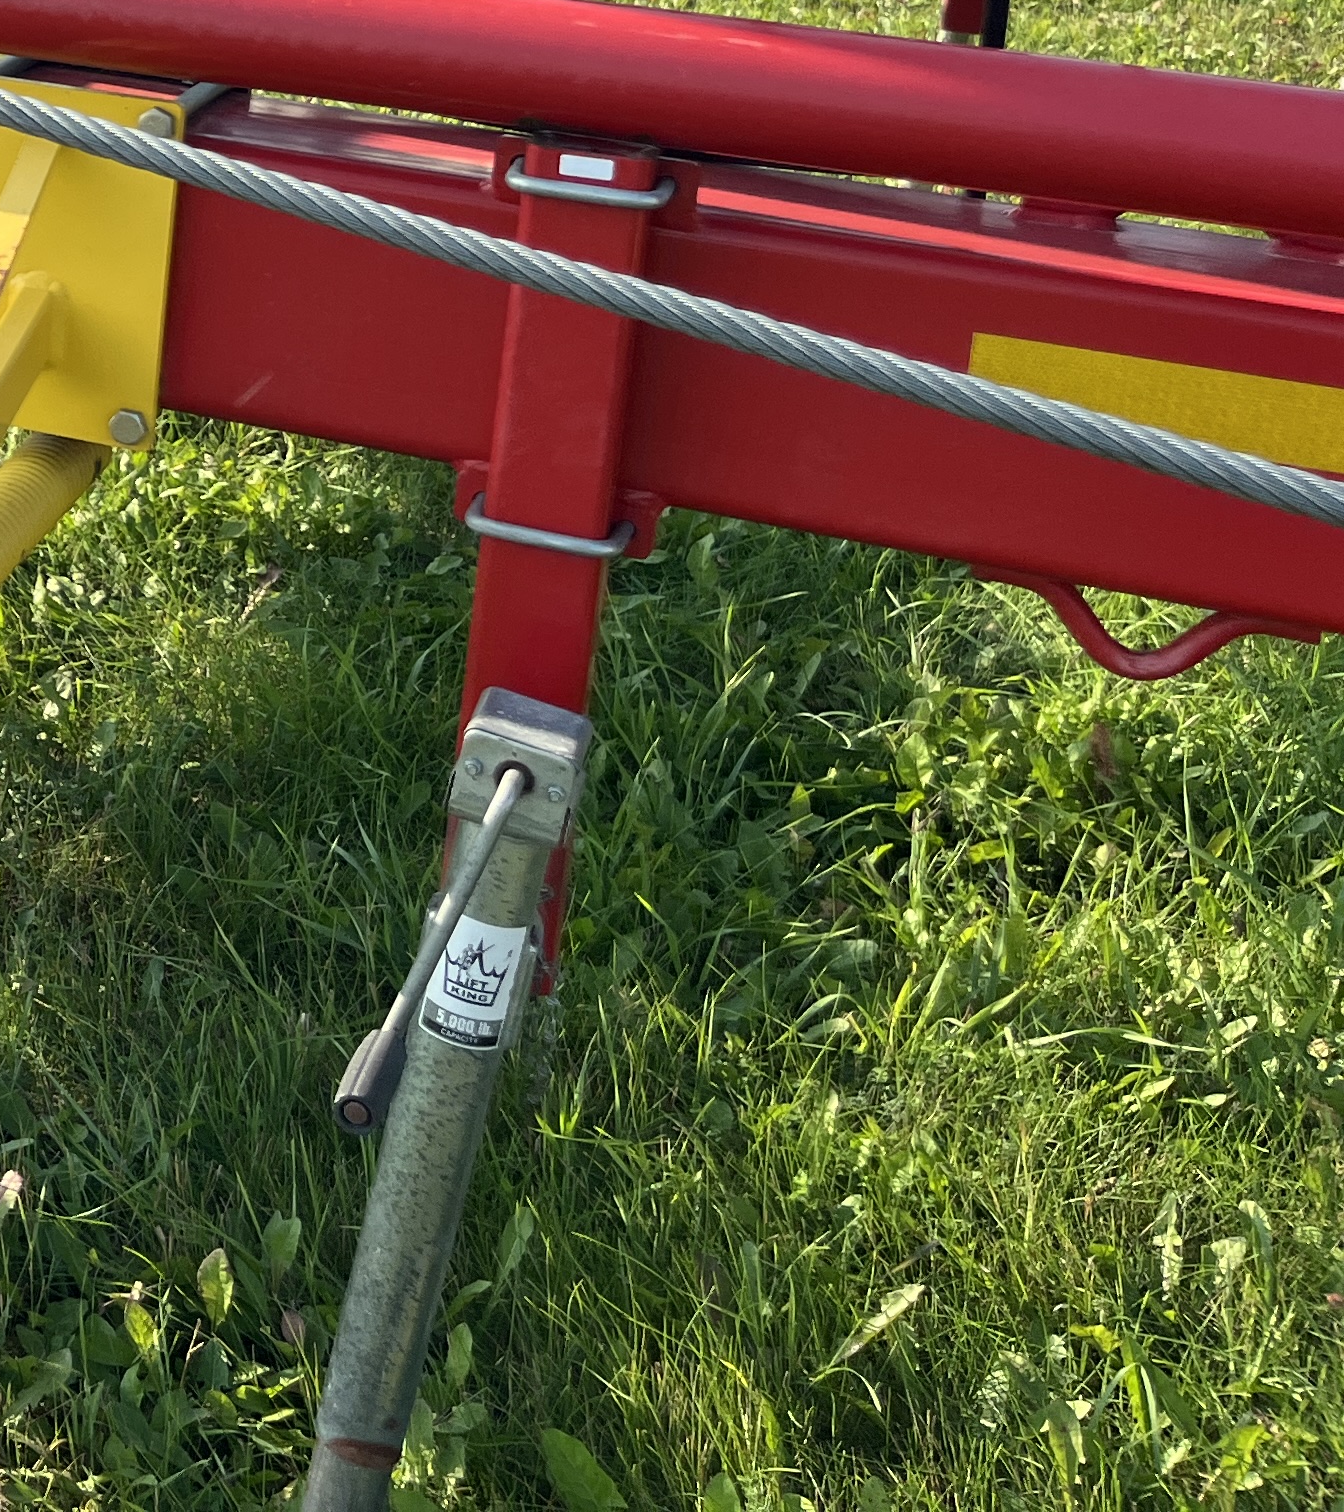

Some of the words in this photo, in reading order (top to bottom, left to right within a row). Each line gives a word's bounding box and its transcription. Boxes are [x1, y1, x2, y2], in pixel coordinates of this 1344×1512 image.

[454, 974, 489, 991] LIFT
[450, 985, 488, 1003] KING
[435, 1007, 476, 1035] 5,000
[439, 1027, 480, 1044] CAPACITY
